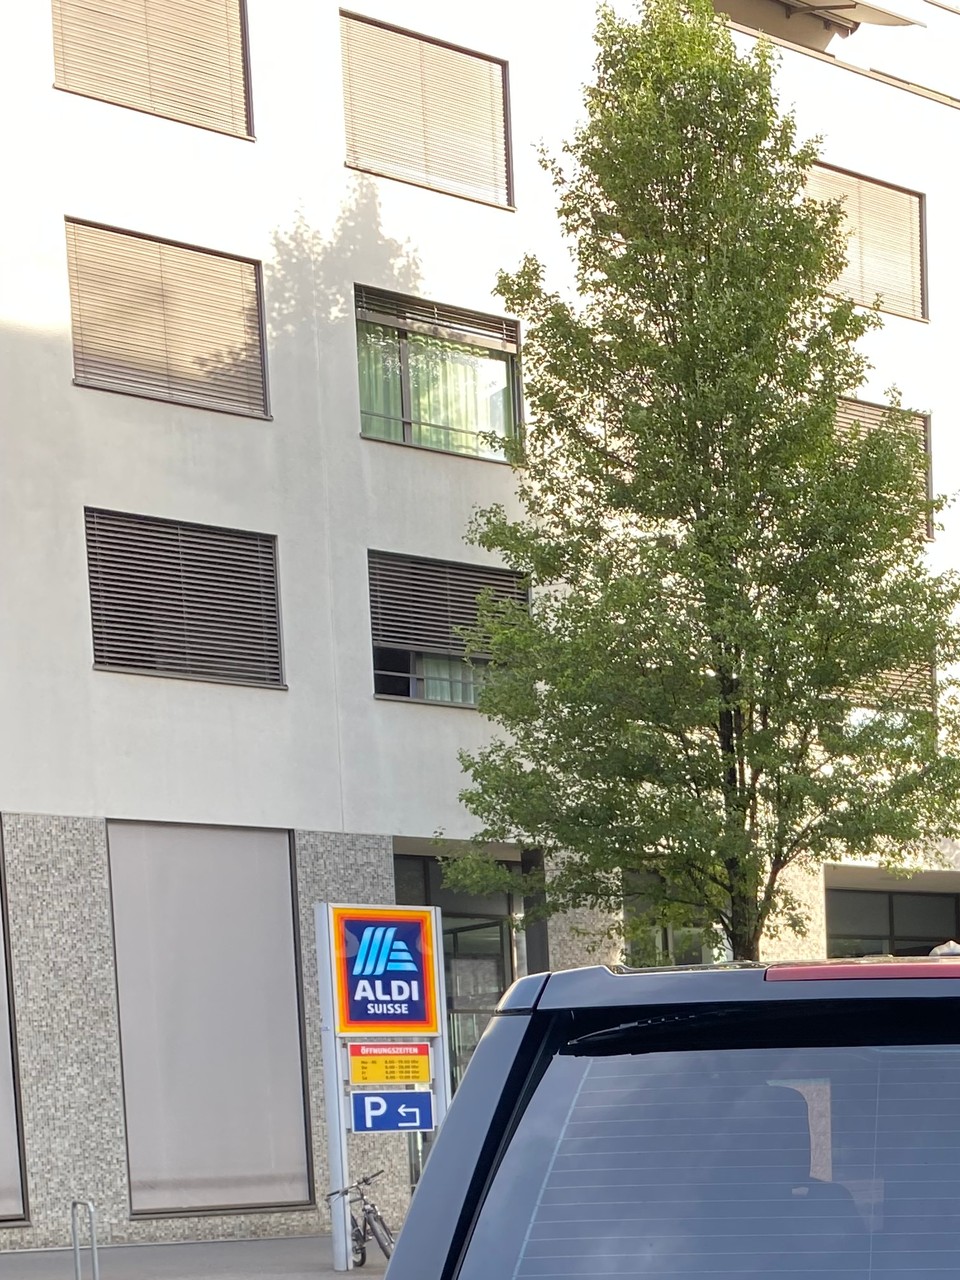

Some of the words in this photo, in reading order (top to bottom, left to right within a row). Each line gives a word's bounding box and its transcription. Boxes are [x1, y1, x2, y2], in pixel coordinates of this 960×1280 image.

[354, 980, 419, 1001] ALDI
[367, 1003, 408, 1015] SUISSE
[360, 1045, 418, 1055] ÖFFNUNGSZEITEN
[364, 1096, 387, 1128] P
